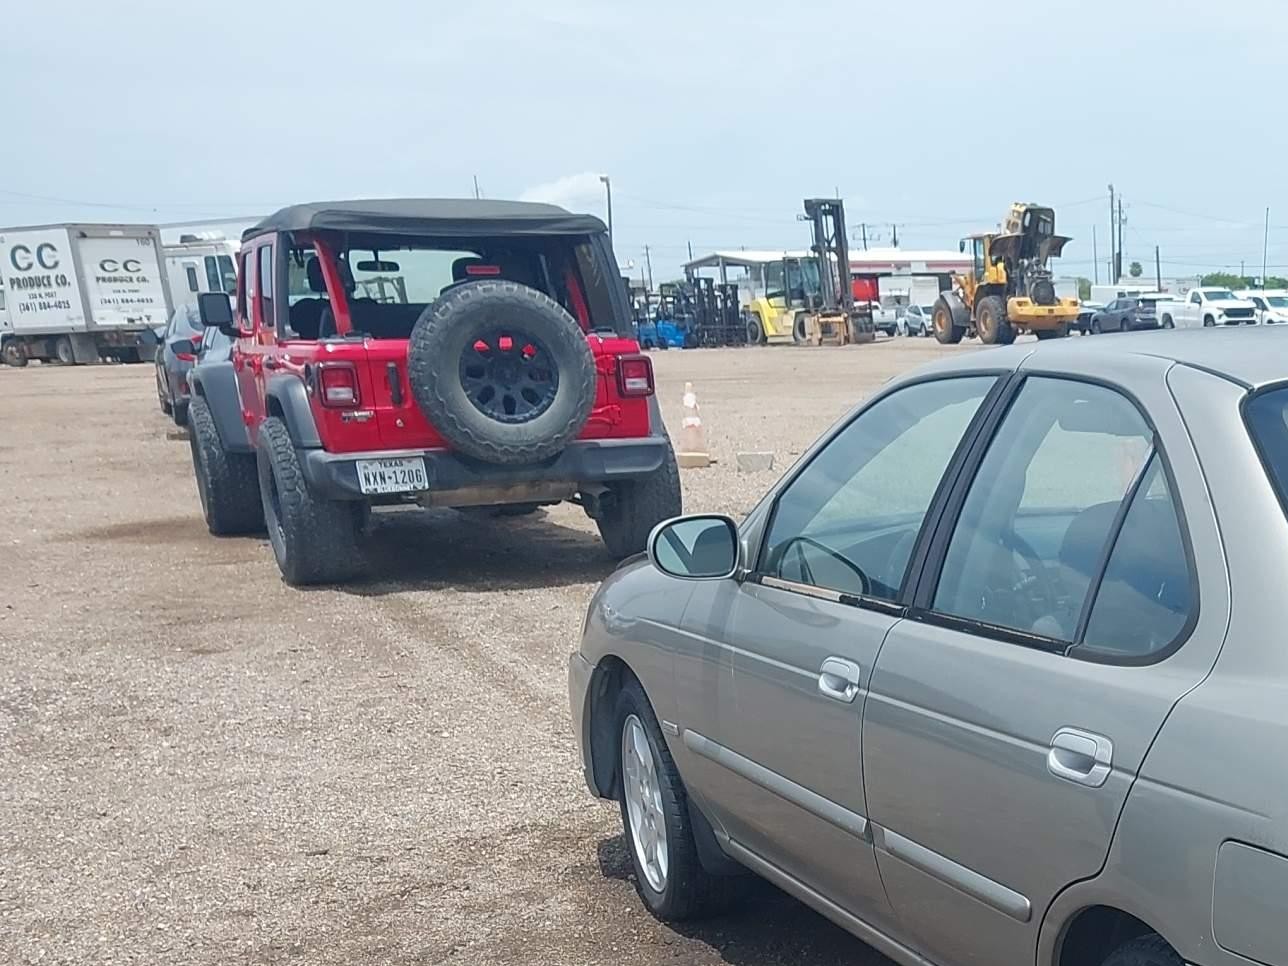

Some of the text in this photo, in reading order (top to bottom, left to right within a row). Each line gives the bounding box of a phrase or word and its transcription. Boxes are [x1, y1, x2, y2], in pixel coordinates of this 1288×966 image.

[9, 274, 71, 290] PRODUCE CO.
[96, 275, 134, 284] PRODUCE
[378, 458, 404, 468] TEXAS
